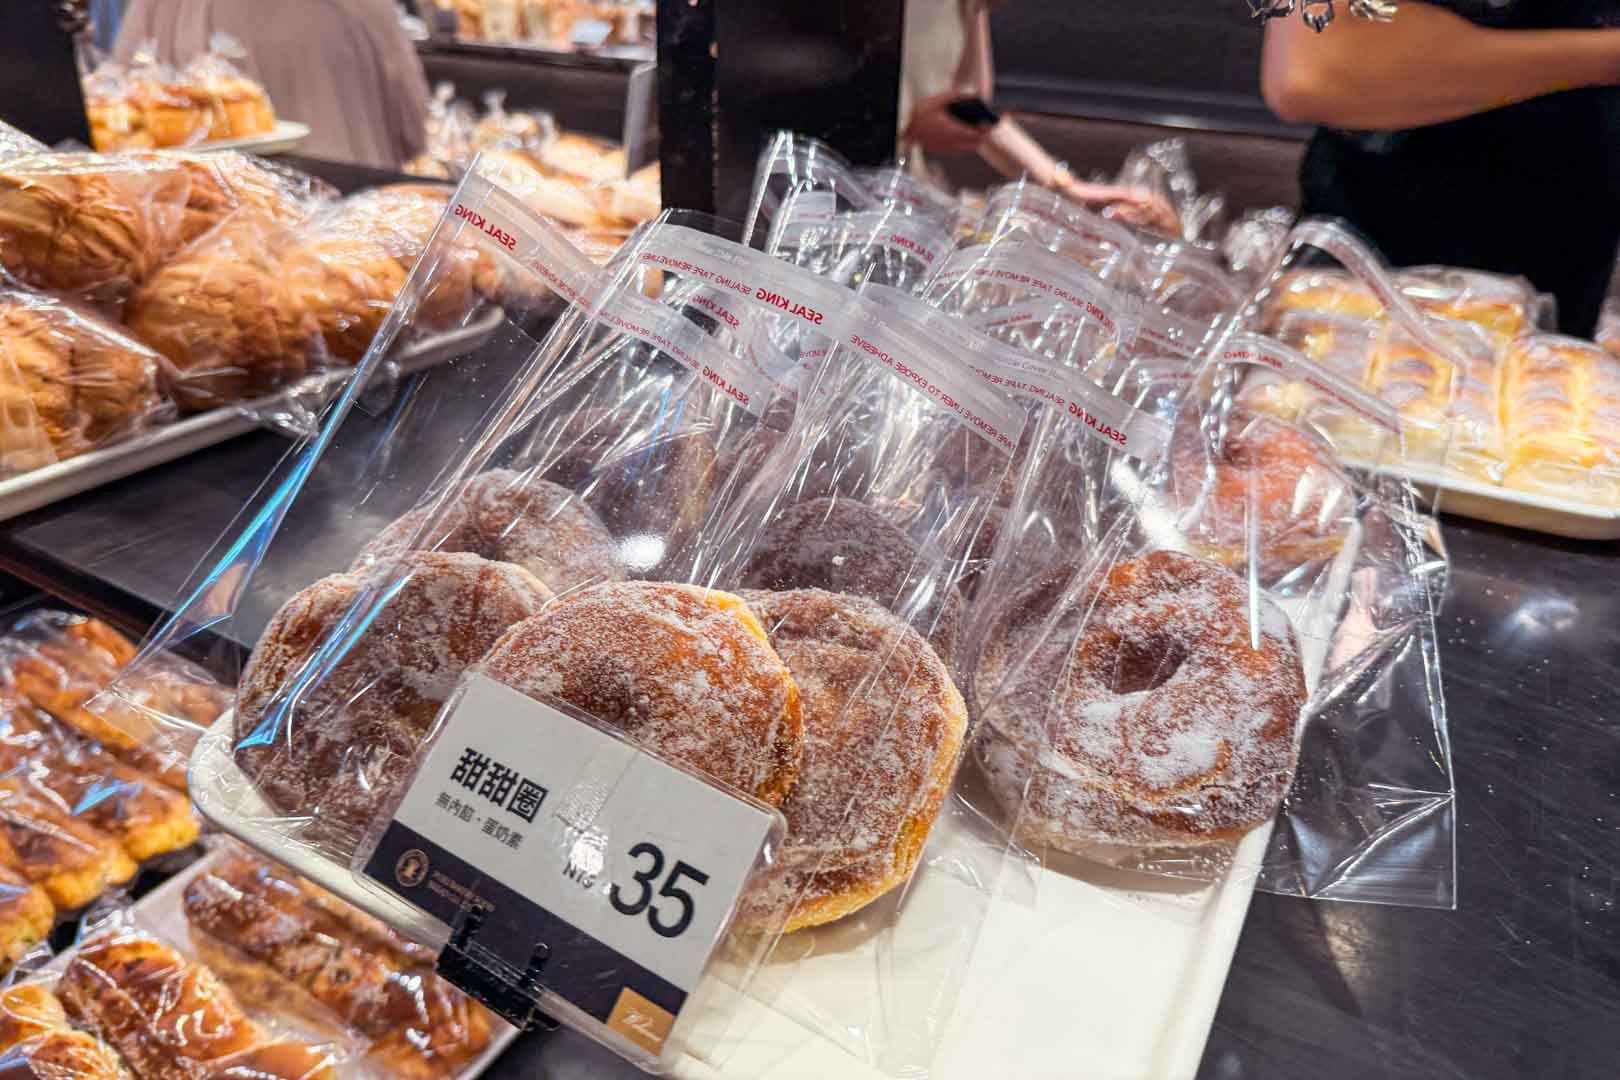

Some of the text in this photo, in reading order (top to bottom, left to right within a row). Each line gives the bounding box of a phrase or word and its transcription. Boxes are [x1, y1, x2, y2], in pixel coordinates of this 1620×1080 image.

[450, 747, 549, 824] 甜甜圈
[609, 842, 710, 938] 35
